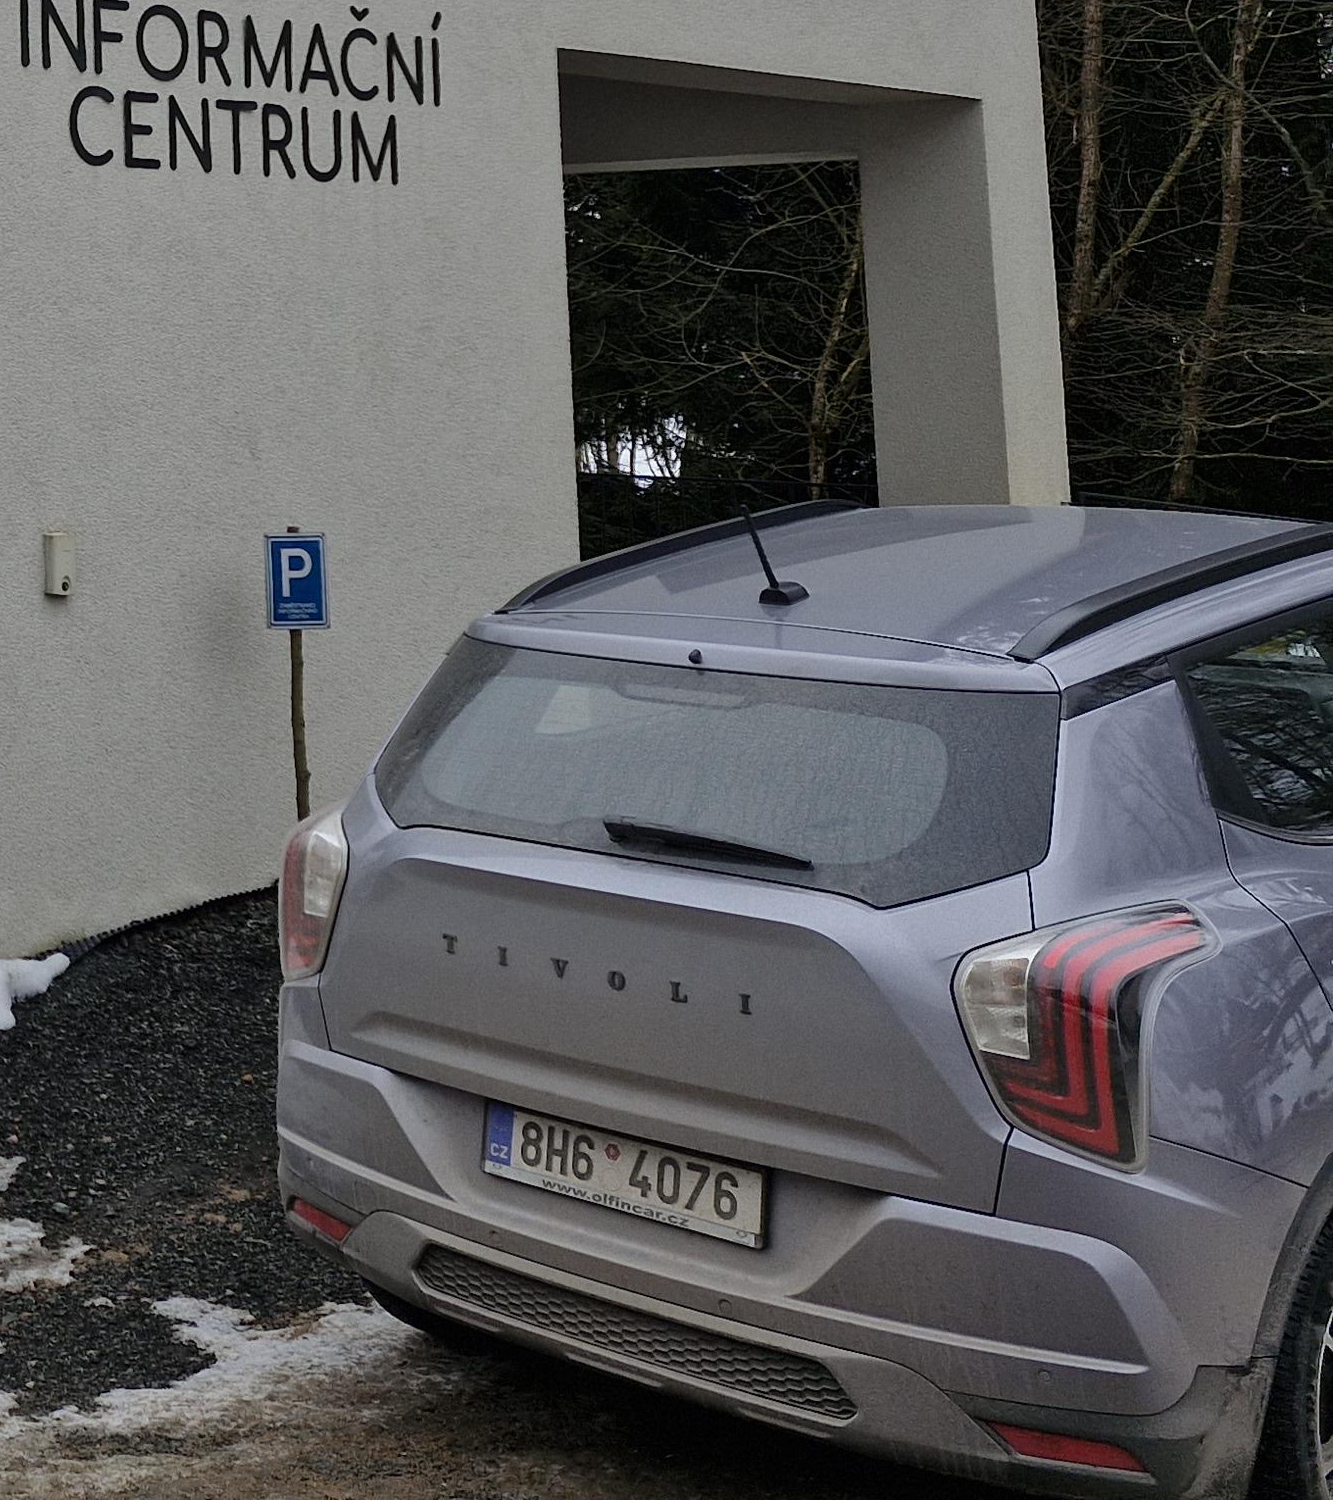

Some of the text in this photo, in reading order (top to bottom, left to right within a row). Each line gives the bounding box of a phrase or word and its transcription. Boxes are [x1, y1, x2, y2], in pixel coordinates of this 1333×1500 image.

[69, 86, 399, 186] CENTRUM
[280, 547, 313, 598] P
[442, 933, 752, 1015] TIVOLI
[490, 1142, 509, 1160] CZ
[520, 1120, 739, 1222] 8H6 4076
[541, 1178, 690, 1229] www.olfincar.cz
